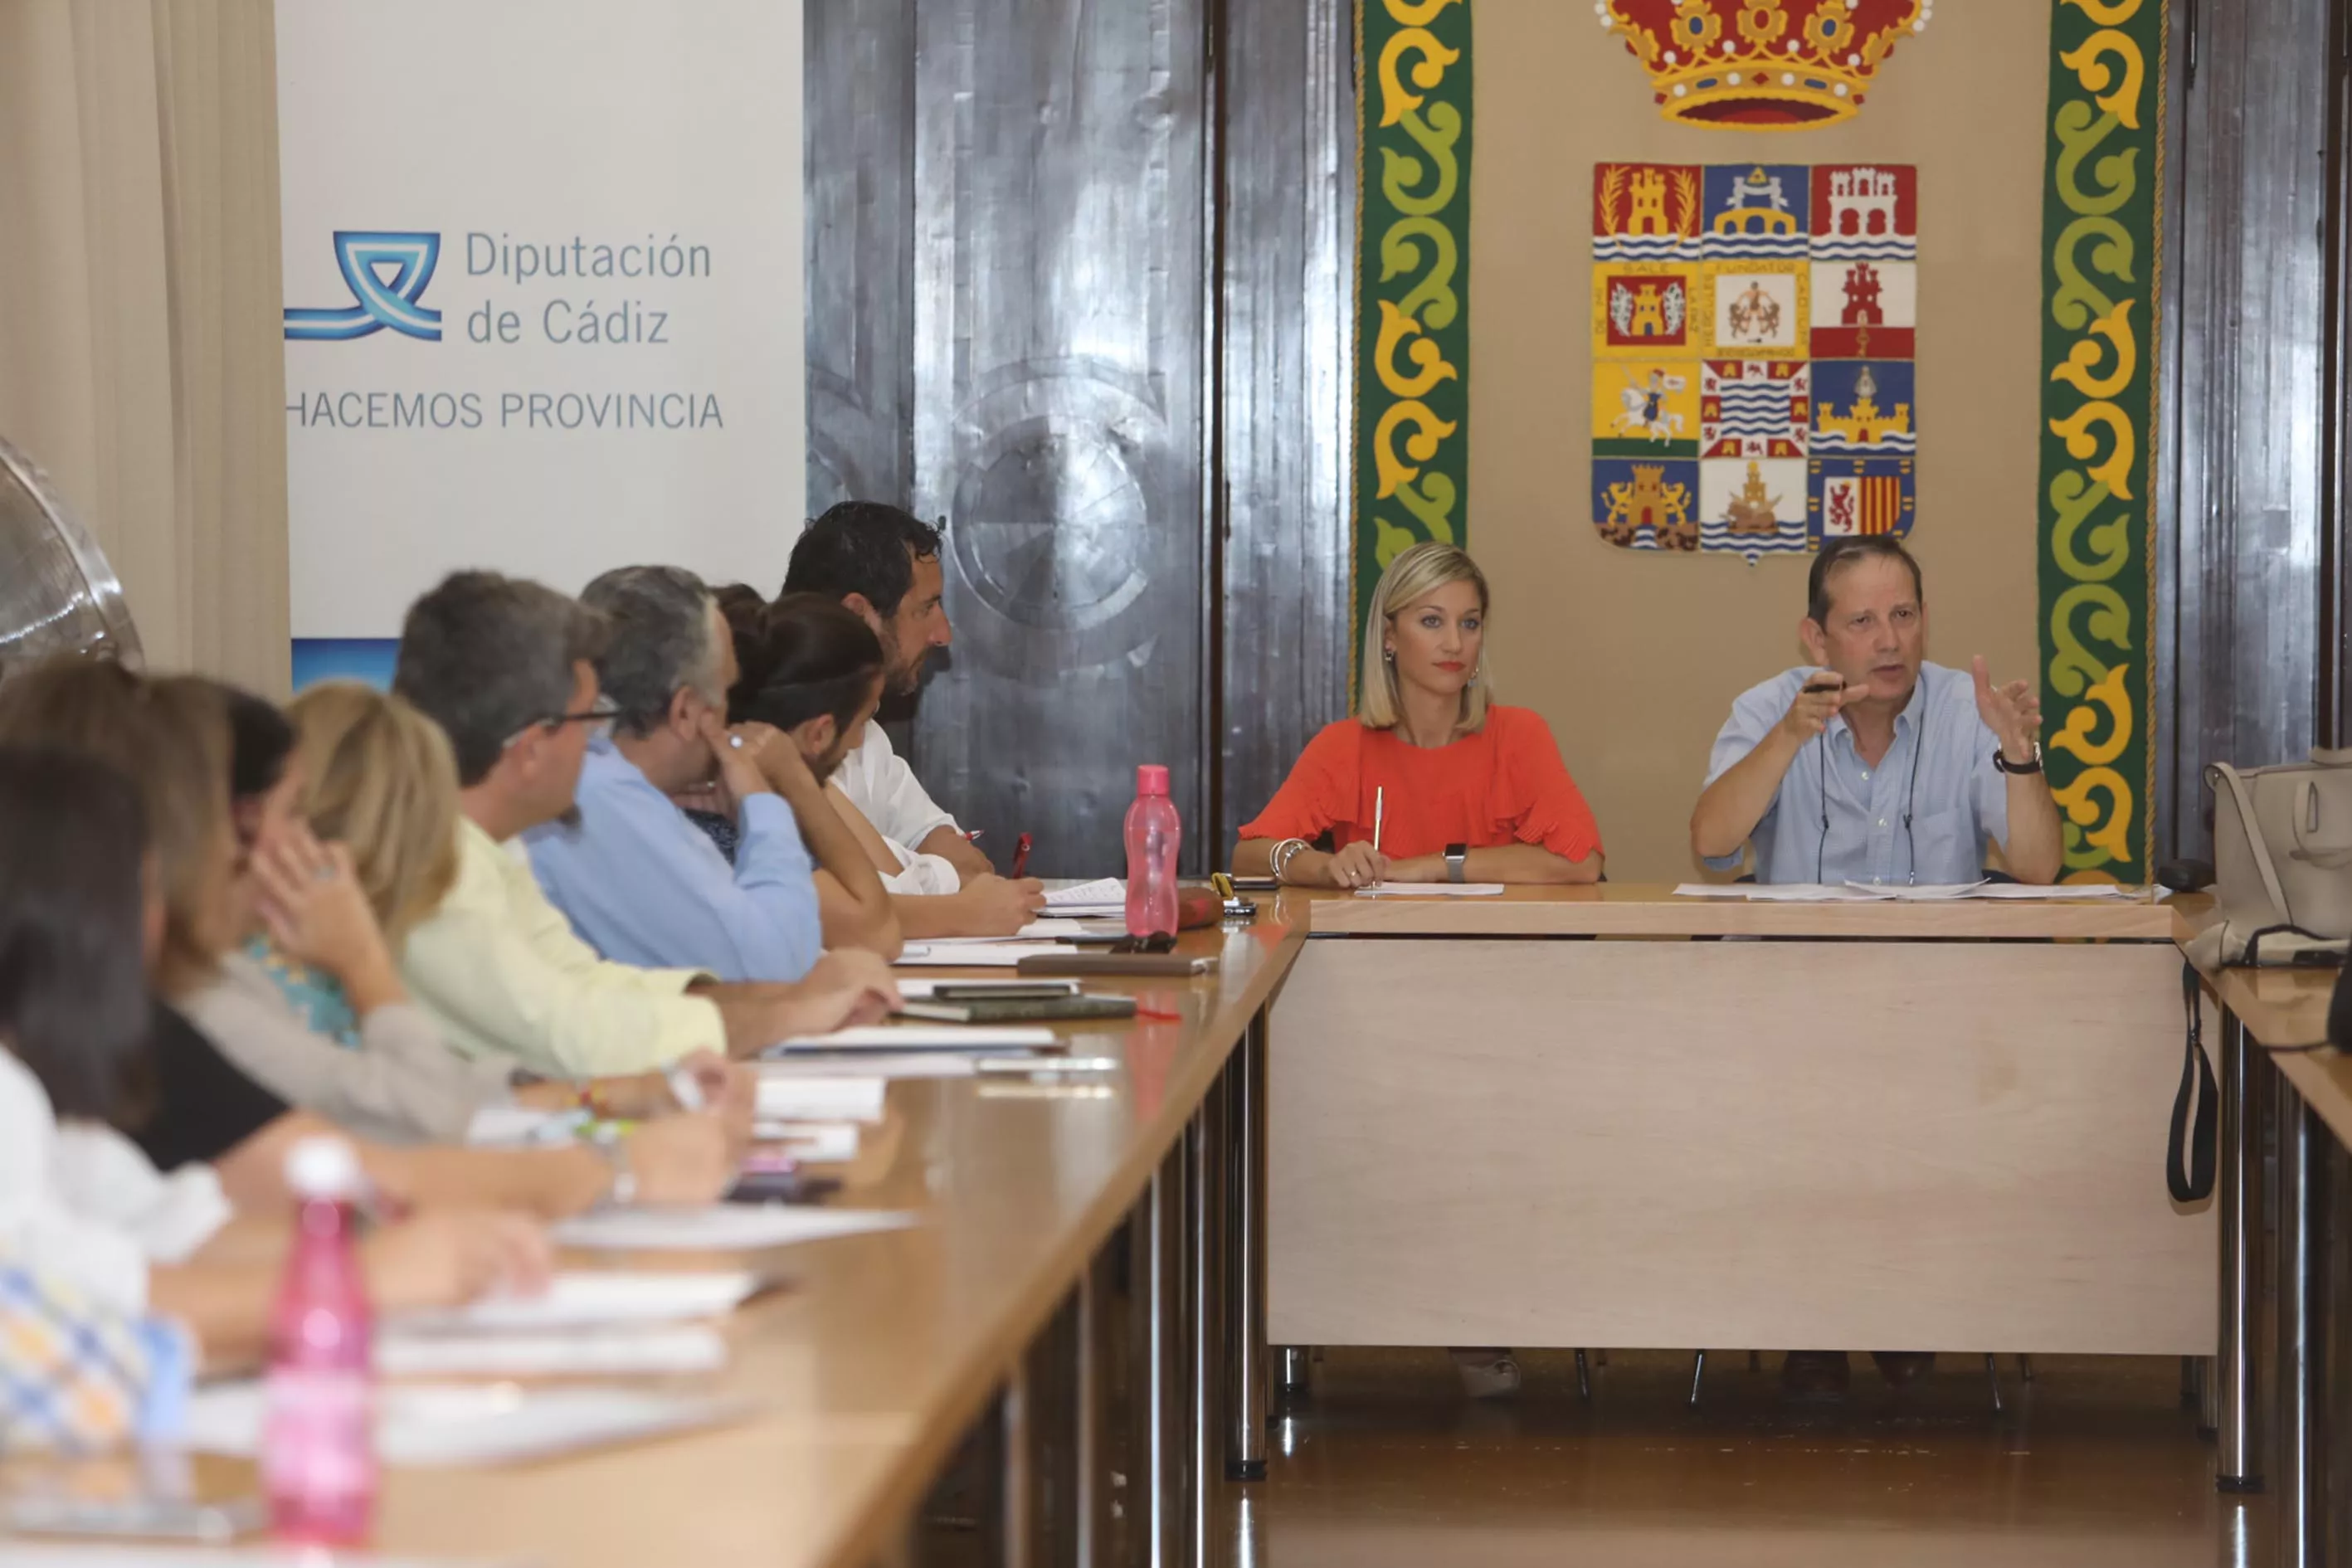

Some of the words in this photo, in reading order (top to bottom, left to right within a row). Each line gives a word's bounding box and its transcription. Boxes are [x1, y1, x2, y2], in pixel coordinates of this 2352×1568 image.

[466, 231, 711, 285] Diputación
[467, 299, 521, 344] de
[543, 298, 669, 344] Cádiz
[285, 392, 483, 429] HACEMOS
[501, 392, 724, 430] PROVINCIA
